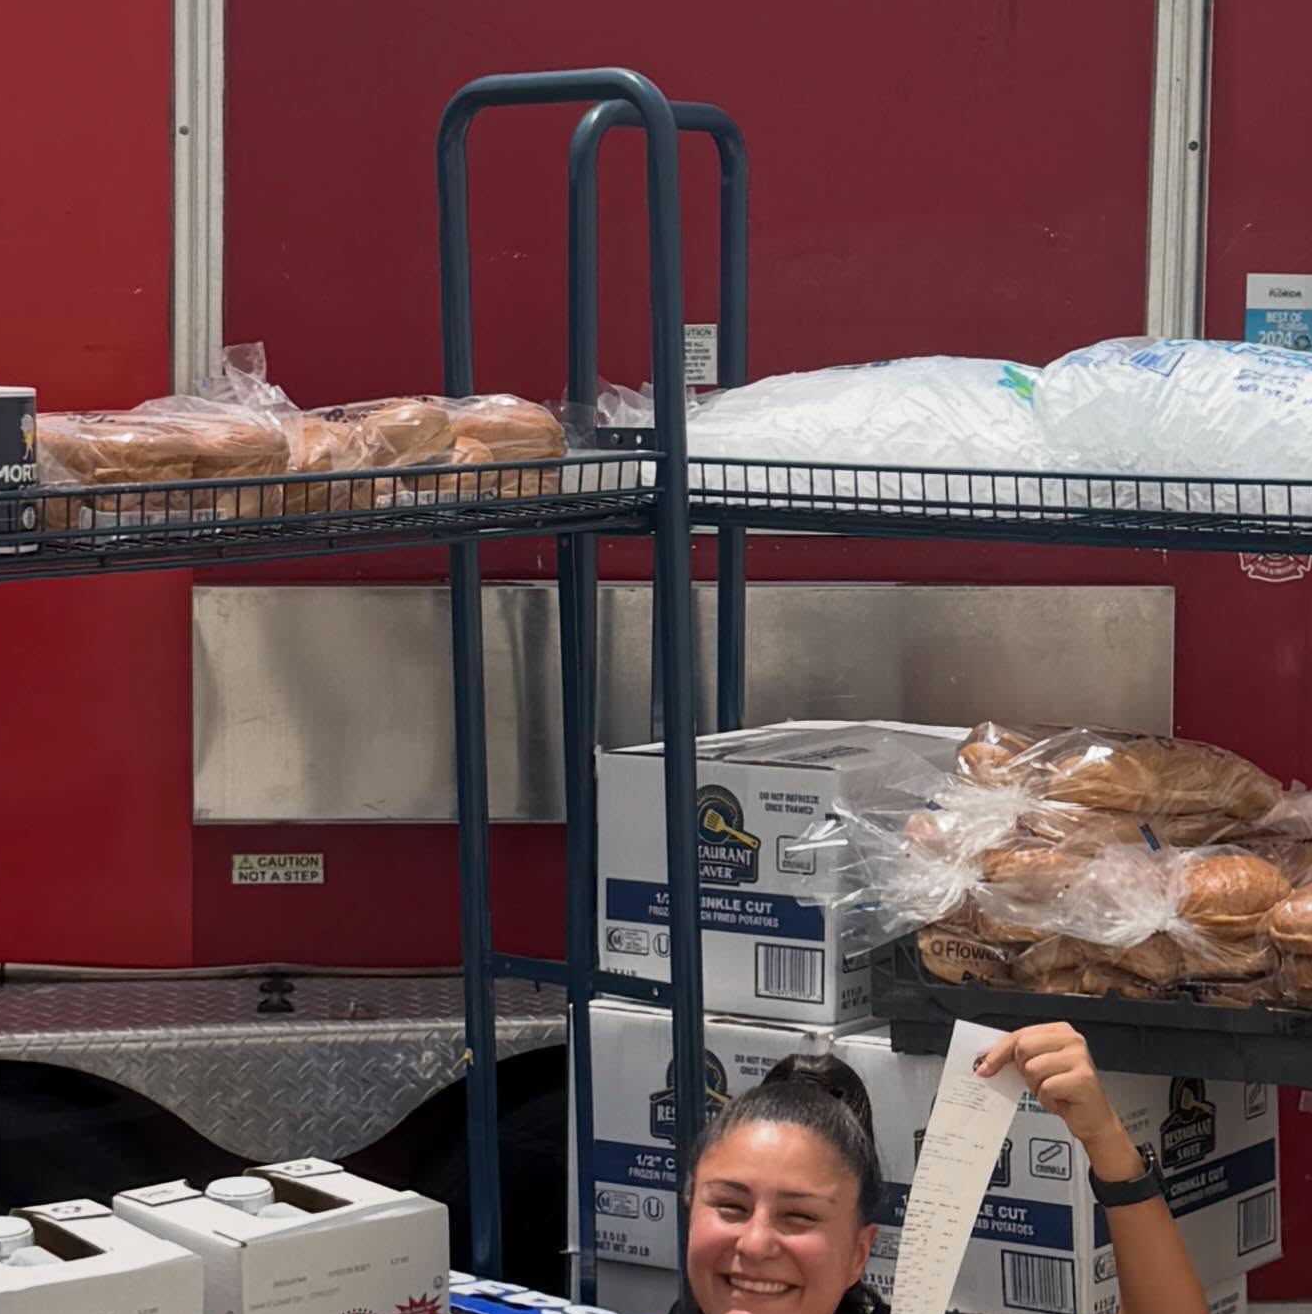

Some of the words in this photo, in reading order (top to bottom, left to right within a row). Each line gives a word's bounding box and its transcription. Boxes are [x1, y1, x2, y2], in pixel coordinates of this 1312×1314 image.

[1265, 311, 1288, 323] BEST
[1290, 312, 1303, 322] OF
[1258, 331, 1293, 347] 2024
[258, 857, 319, 868] CAUTION
[238, 871, 266, 882] NOT
[271, 871, 280, 881] A
[284, 870, 319, 881] STEP
[745, 900, 773, 914] CUT
[738, 915, 779, 928] POTATOES
[1208, 1166, 1225, 1184] CUT
[998, 1207, 1027, 1221] CUT
[991, 1220, 1034, 1236] POTATOES
